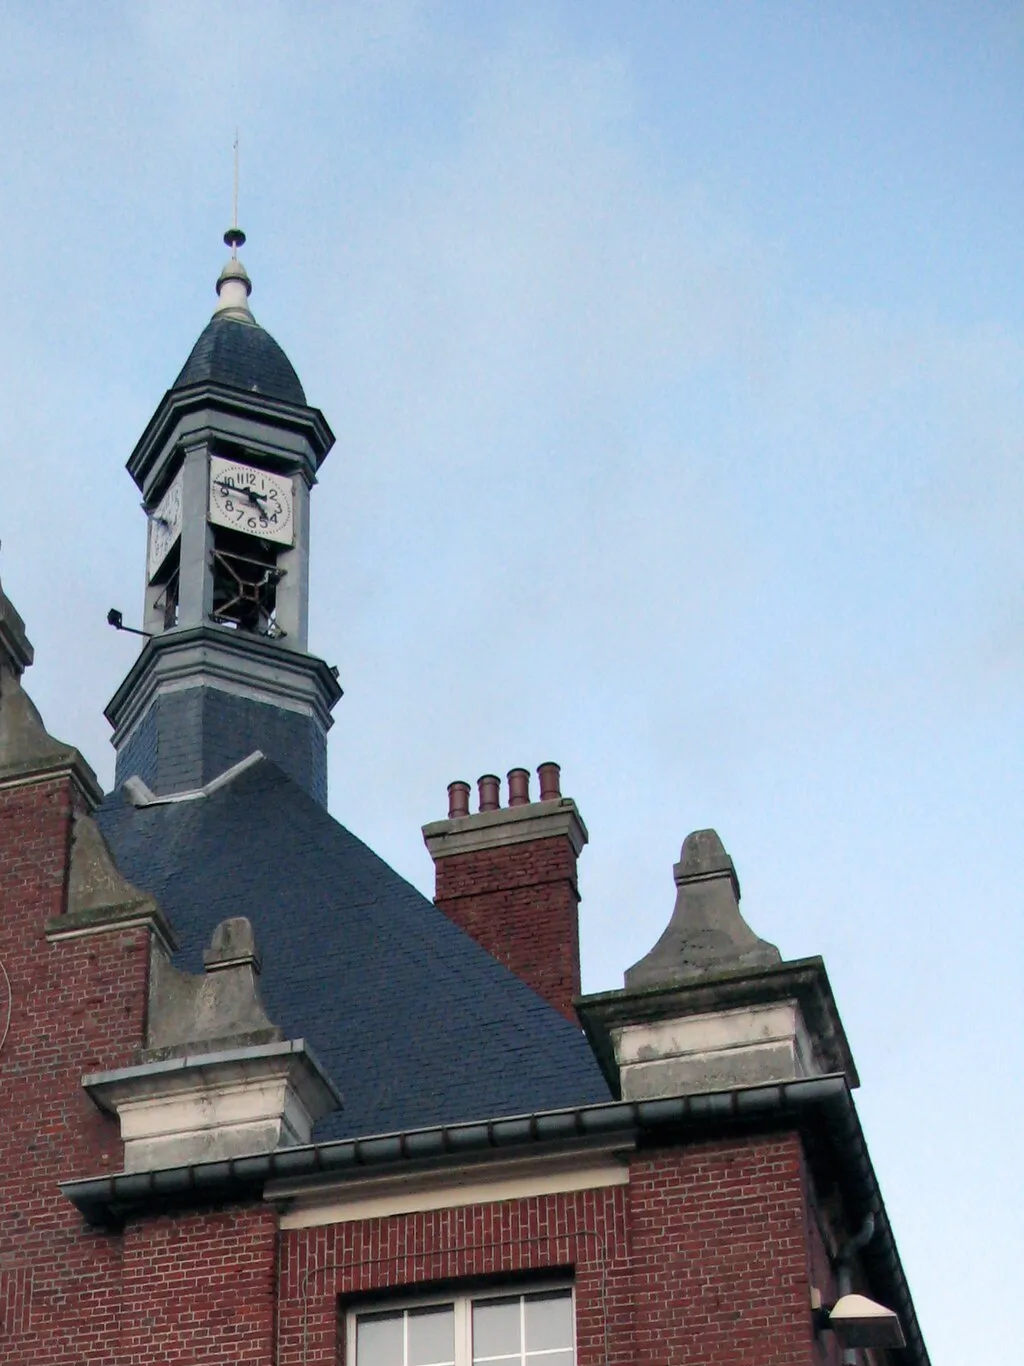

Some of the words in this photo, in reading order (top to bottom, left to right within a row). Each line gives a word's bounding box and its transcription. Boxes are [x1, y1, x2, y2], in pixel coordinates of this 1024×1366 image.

[224, 476, 235, 488] 10
[237, 473, 244, 484] 11
[246, 473, 256, 486] 12
[220, 487, 229, 498] 9
[269, 489, 278, 501] 2
[225, 500, 234, 512] 8
[274, 503, 283, 514] 3
[236, 510, 244, 521] 7
[259, 515, 268, 528] 5
[270, 513, 278, 524] 4
[247, 517, 257, 529] 6
